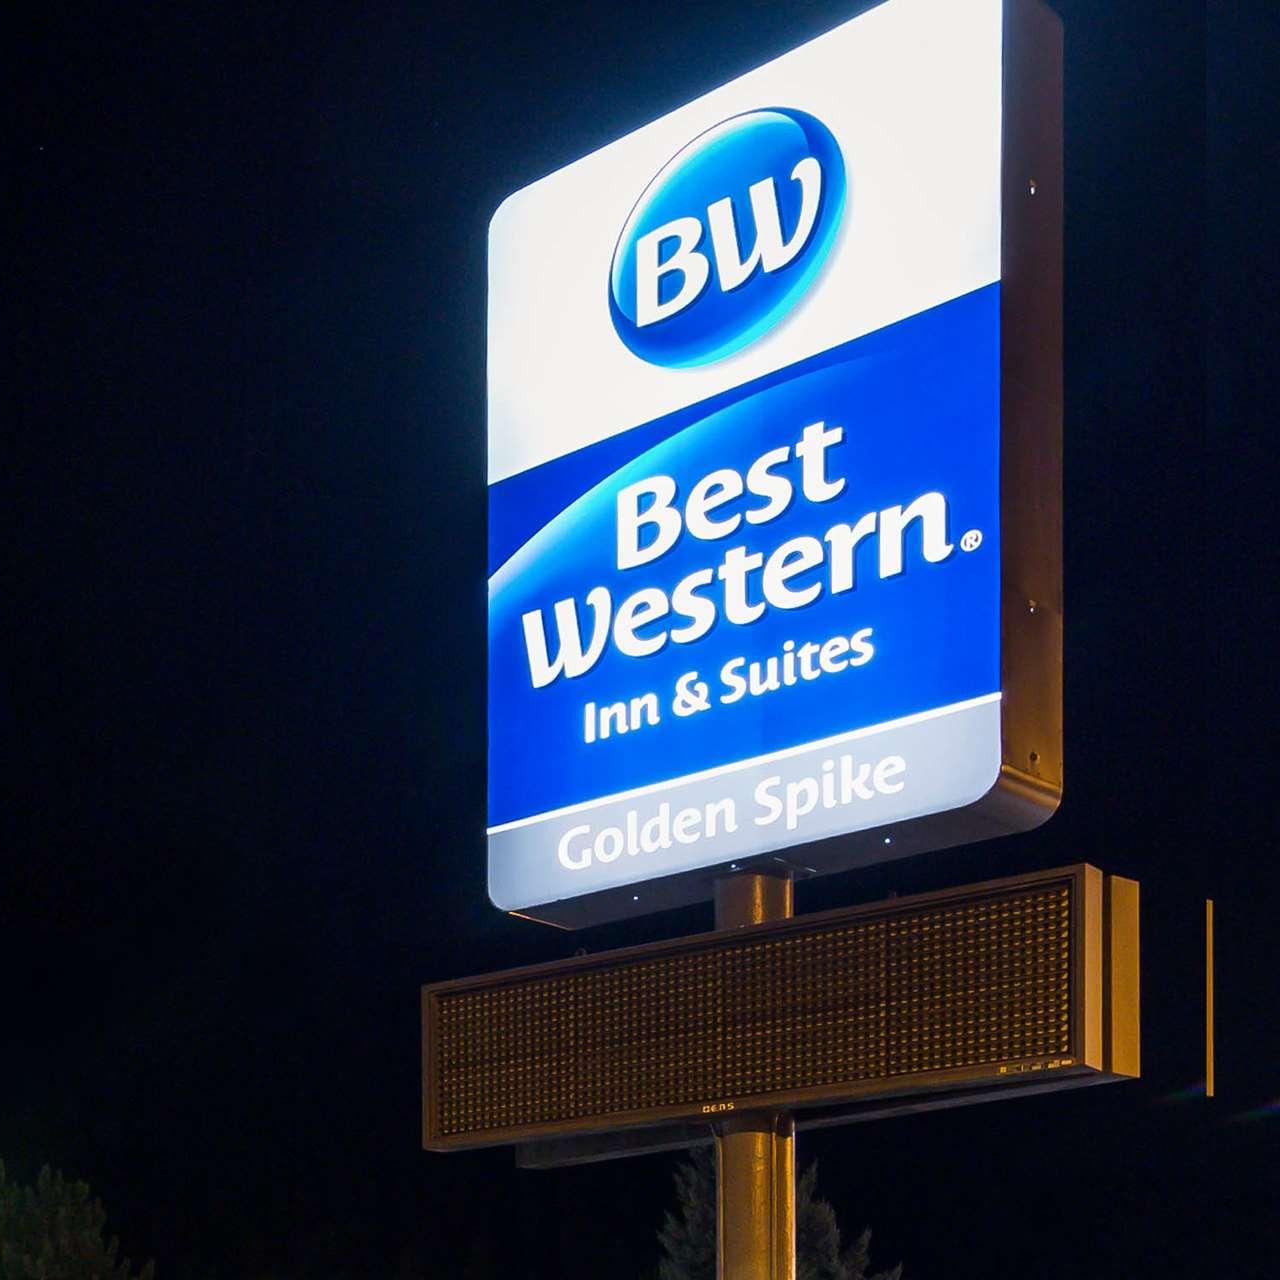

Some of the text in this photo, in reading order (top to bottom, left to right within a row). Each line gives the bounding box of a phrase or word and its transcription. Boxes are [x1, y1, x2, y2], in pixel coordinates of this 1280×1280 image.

[636, 156, 822, 328] BW
[616, 420, 846, 570] Best
[583, 628, 875, 743] Inn & Suites
[556, 754, 907, 871] Golden Spike
